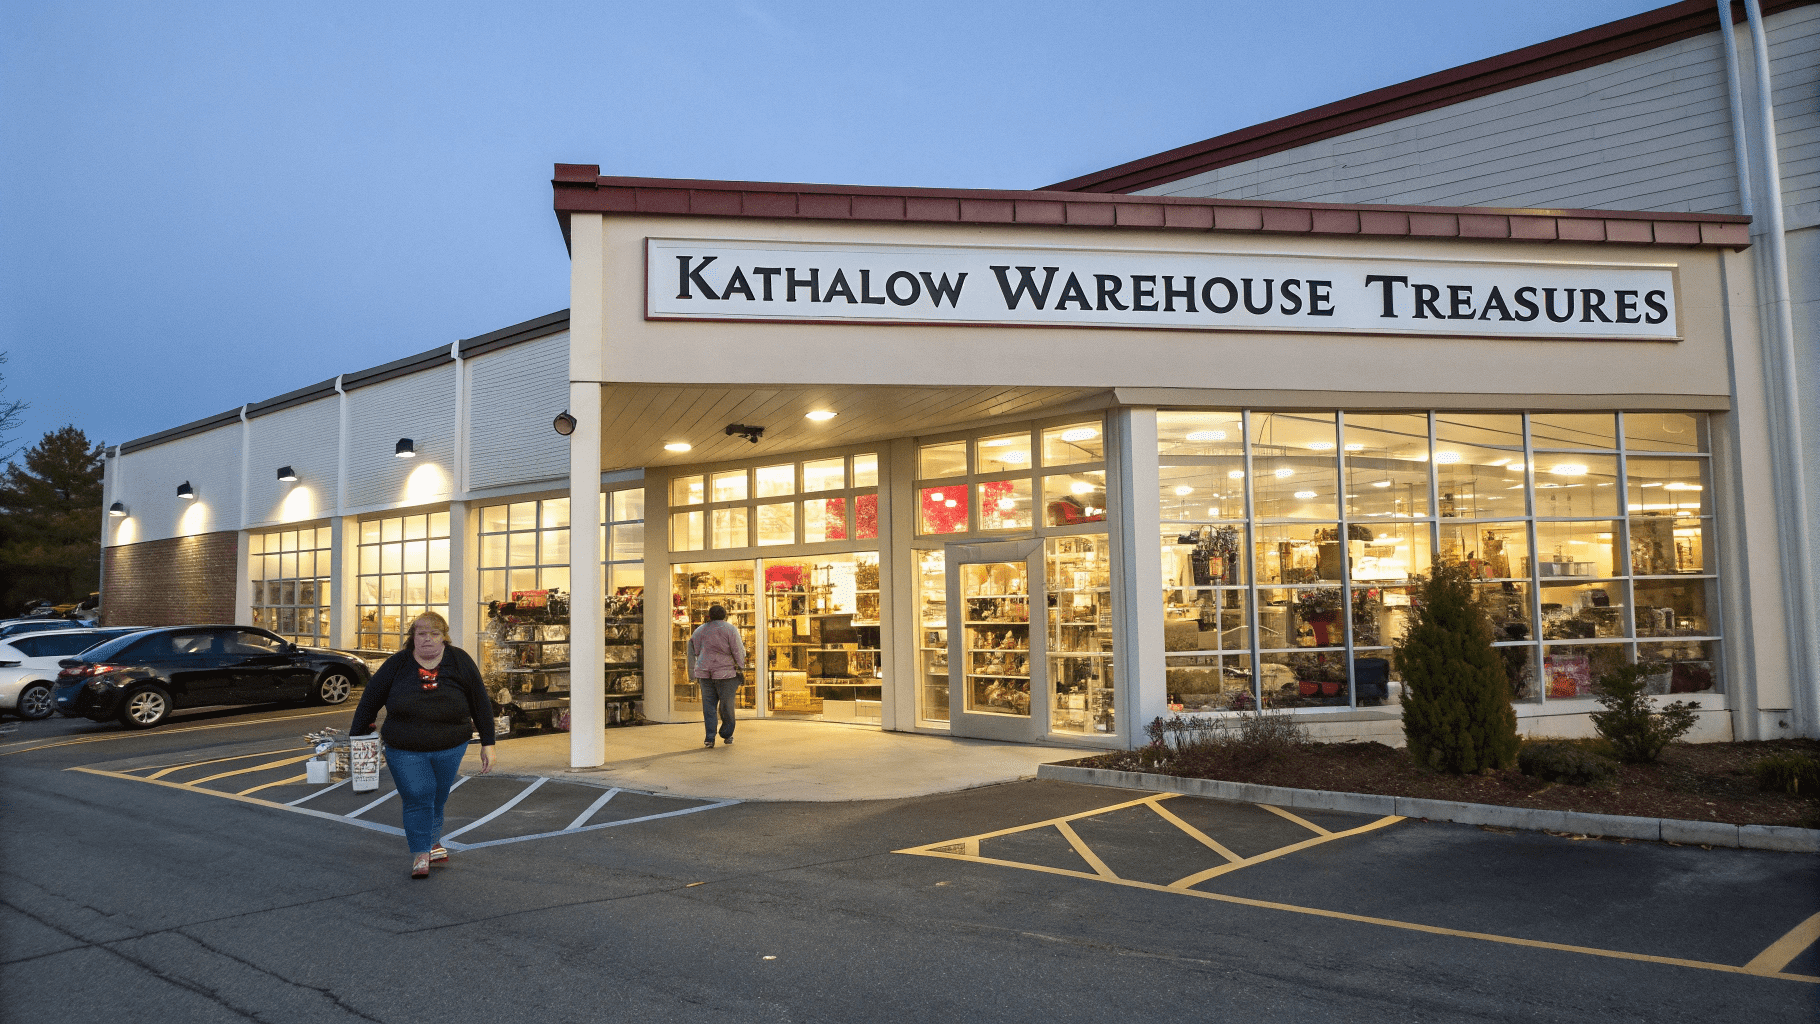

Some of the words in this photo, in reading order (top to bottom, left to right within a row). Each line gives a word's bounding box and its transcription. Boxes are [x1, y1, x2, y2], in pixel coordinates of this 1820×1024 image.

[675, 255, 969, 309] KATHALOW
[989, 265, 1335, 317] WAREHOUSE
[1365, 275, 1669, 325] TREASURES
